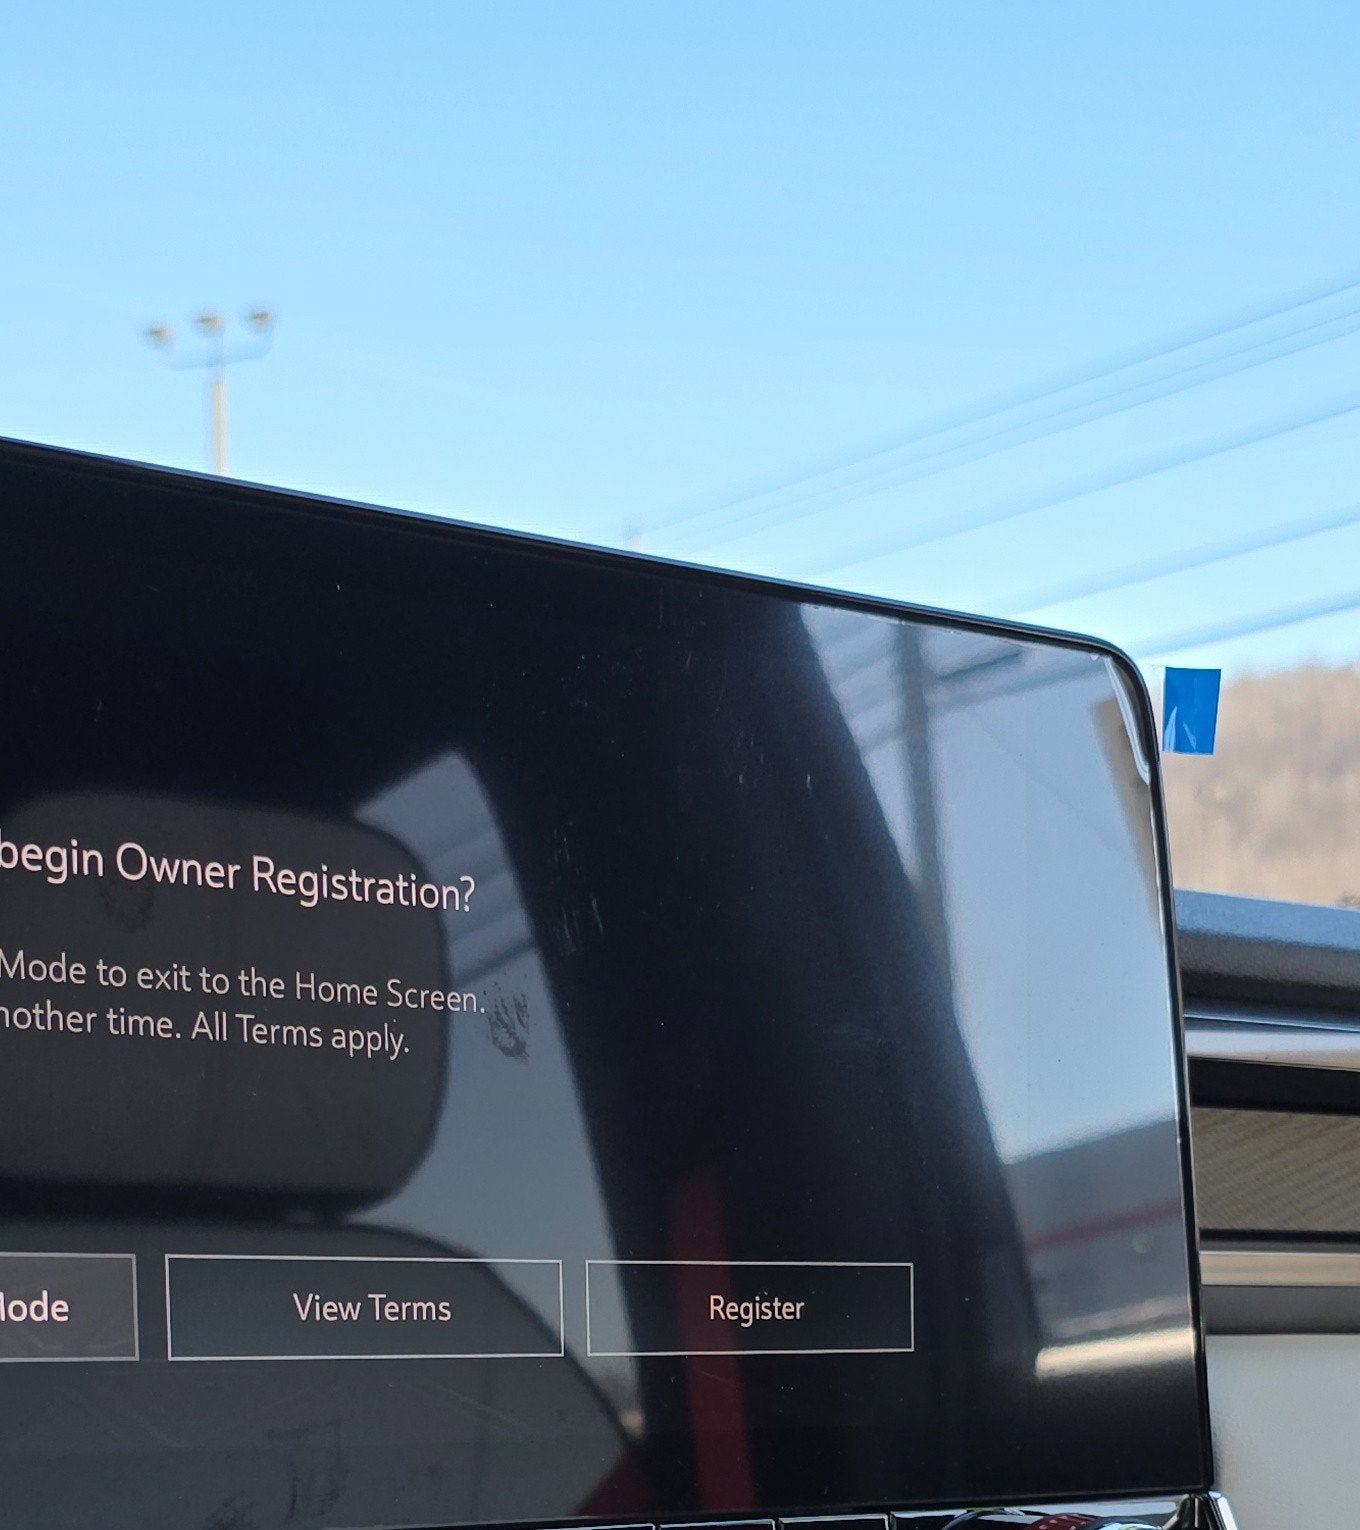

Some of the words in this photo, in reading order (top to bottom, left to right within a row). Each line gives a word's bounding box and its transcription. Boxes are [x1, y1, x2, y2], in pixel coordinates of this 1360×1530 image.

[115, 840, 242, 890] Owner
[252, 853, 476, 914] Registration?
[97, 957, 127, 988] to
[137, 962, 193, 993] exit
[199, 966, 230, 997] to
[238, 965, 286, 1000] the
[295, 970, 380, 1007] Home
[386, 978, 487, 1014] Screen.
[107, 1007, 182, 1040] time.
[190, 1008, 228, 1043] All
[234, 1013, 323, 1050] Terms
[330, 1020, 410, 1065] apply.
[293, 1289, 362, 1322] View
[369, 1293, 452, 1323] Terms
[709, 1292, 805, 1328] Register
